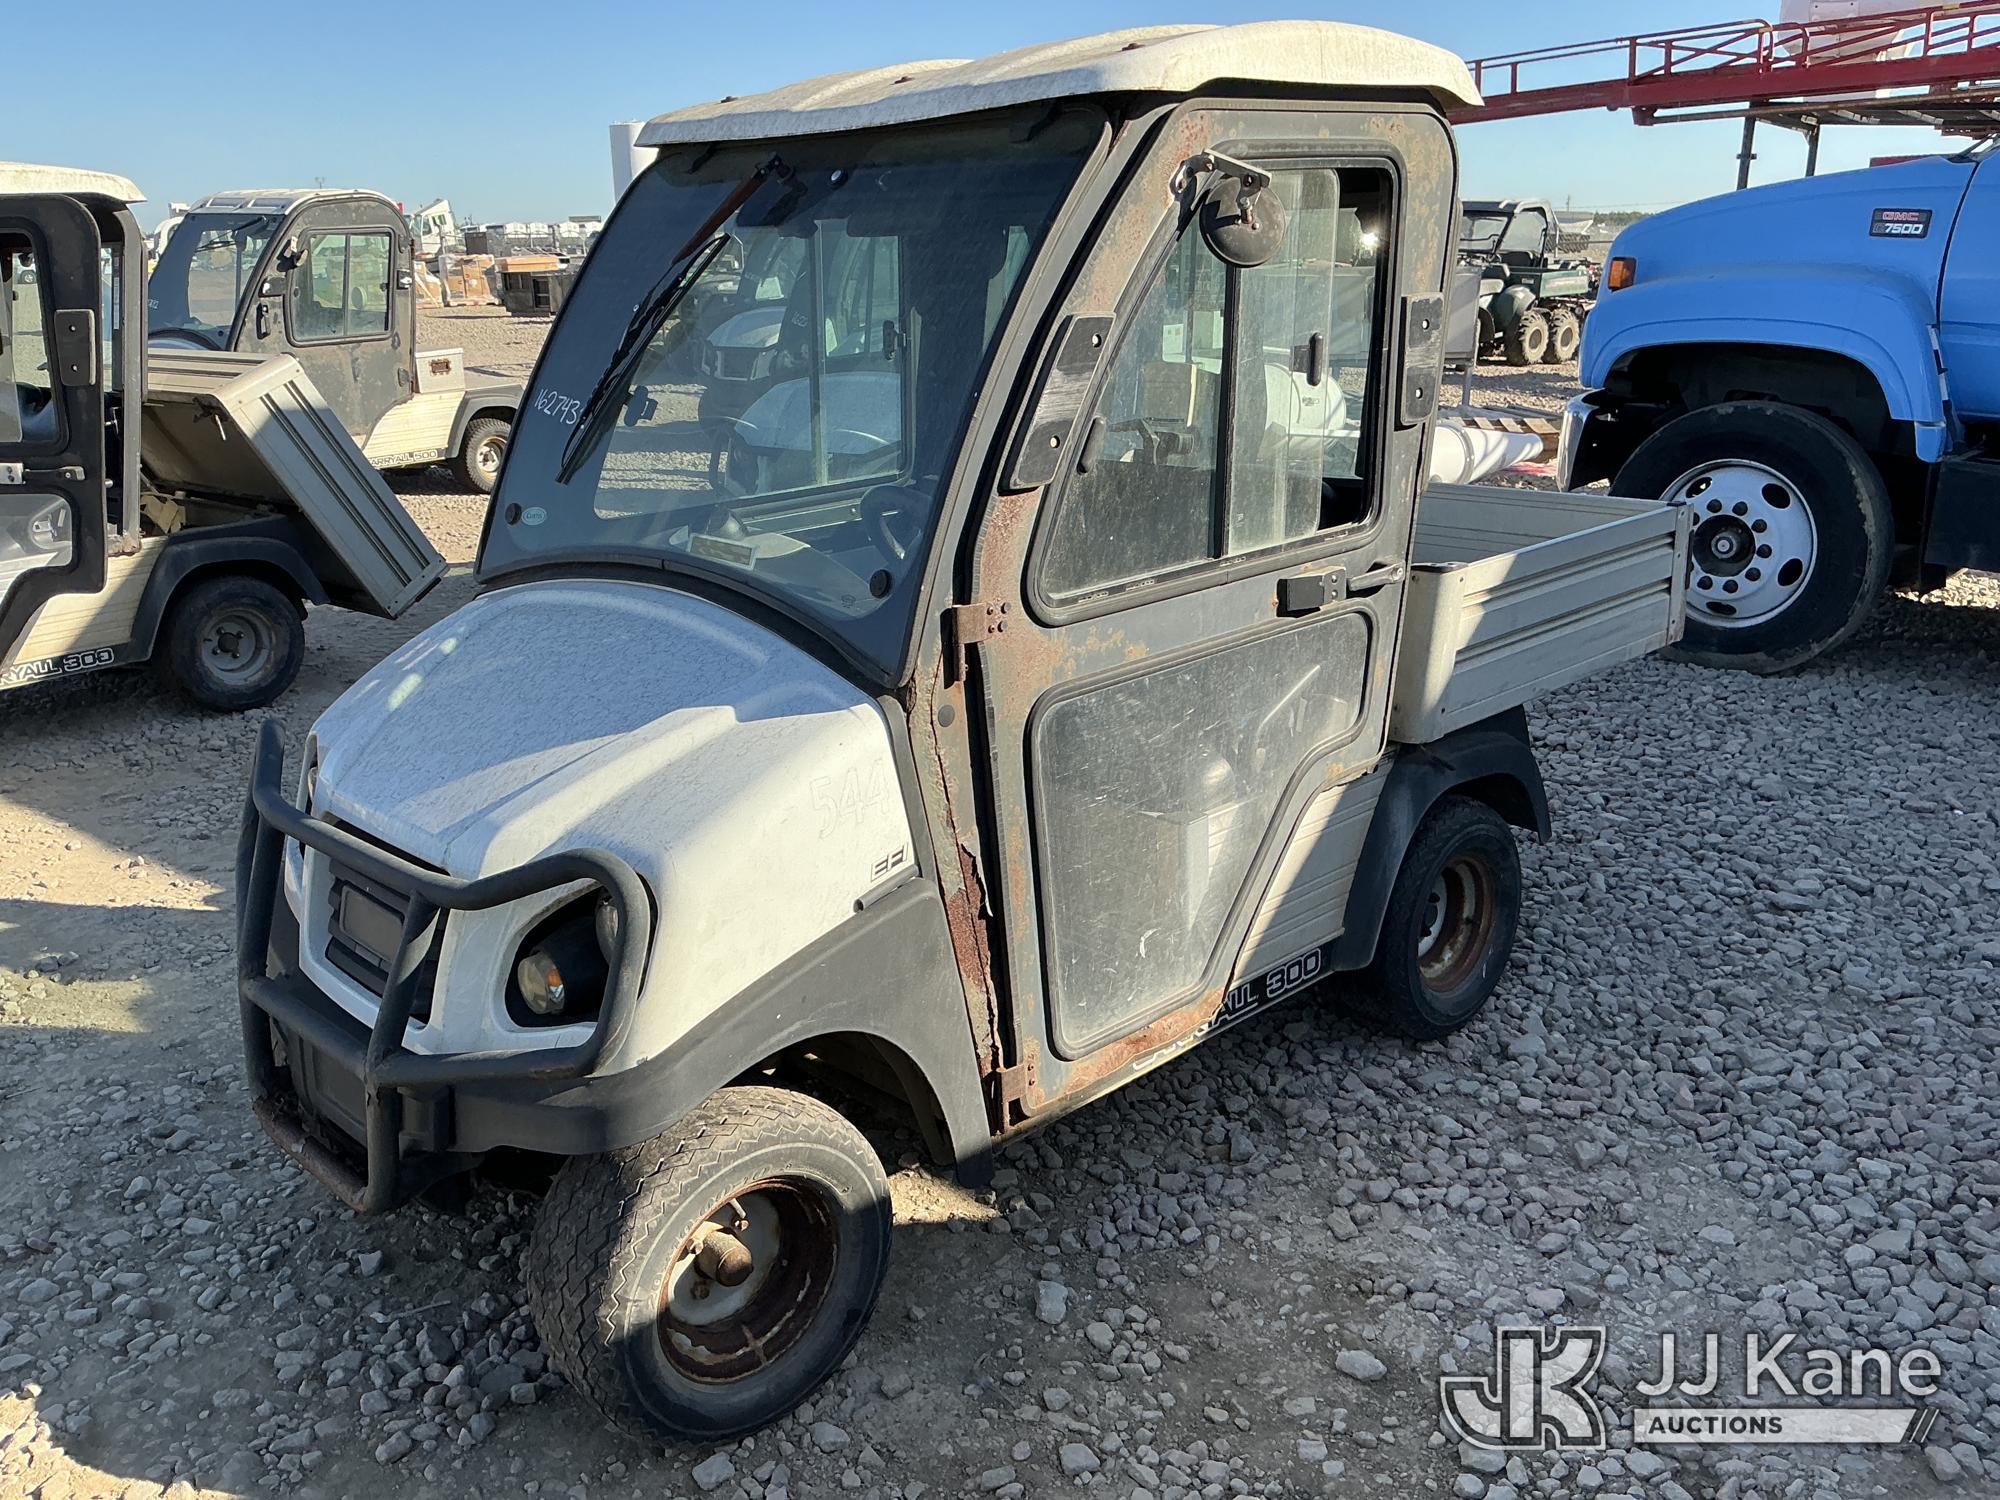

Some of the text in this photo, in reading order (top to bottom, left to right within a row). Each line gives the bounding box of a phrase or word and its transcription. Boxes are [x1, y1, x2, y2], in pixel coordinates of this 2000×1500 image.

[1882, 211, 1919, 221] GMC
[534, 388, 581, 425] 162743
[369, 449, 438, 466] ARRYALL 500
[870, 841, 909, 883] EFI
[1267, 947, 1322, 999] 300
